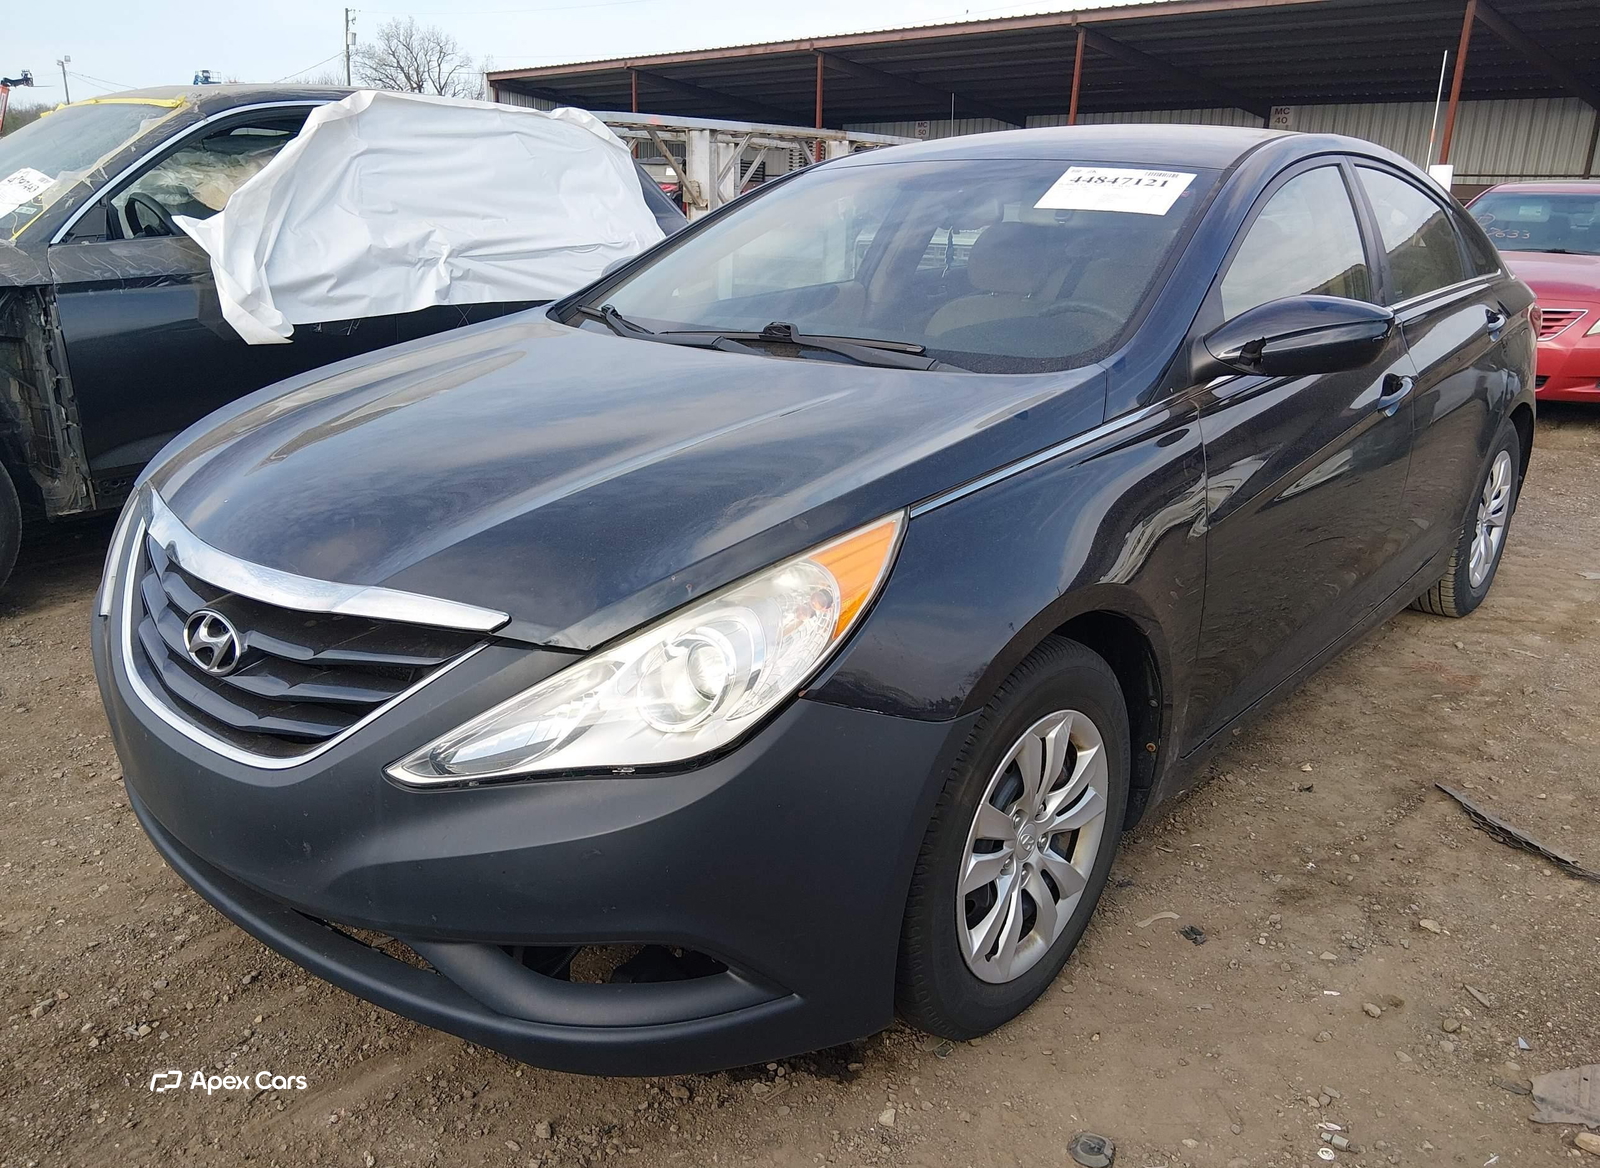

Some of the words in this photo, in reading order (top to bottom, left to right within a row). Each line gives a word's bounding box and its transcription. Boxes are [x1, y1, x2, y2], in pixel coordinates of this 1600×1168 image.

[1275, 107, 1290, 115] MC
[1274, 116, 1288, 124] 40
[1069, 175, 1168, 188] 44847121
